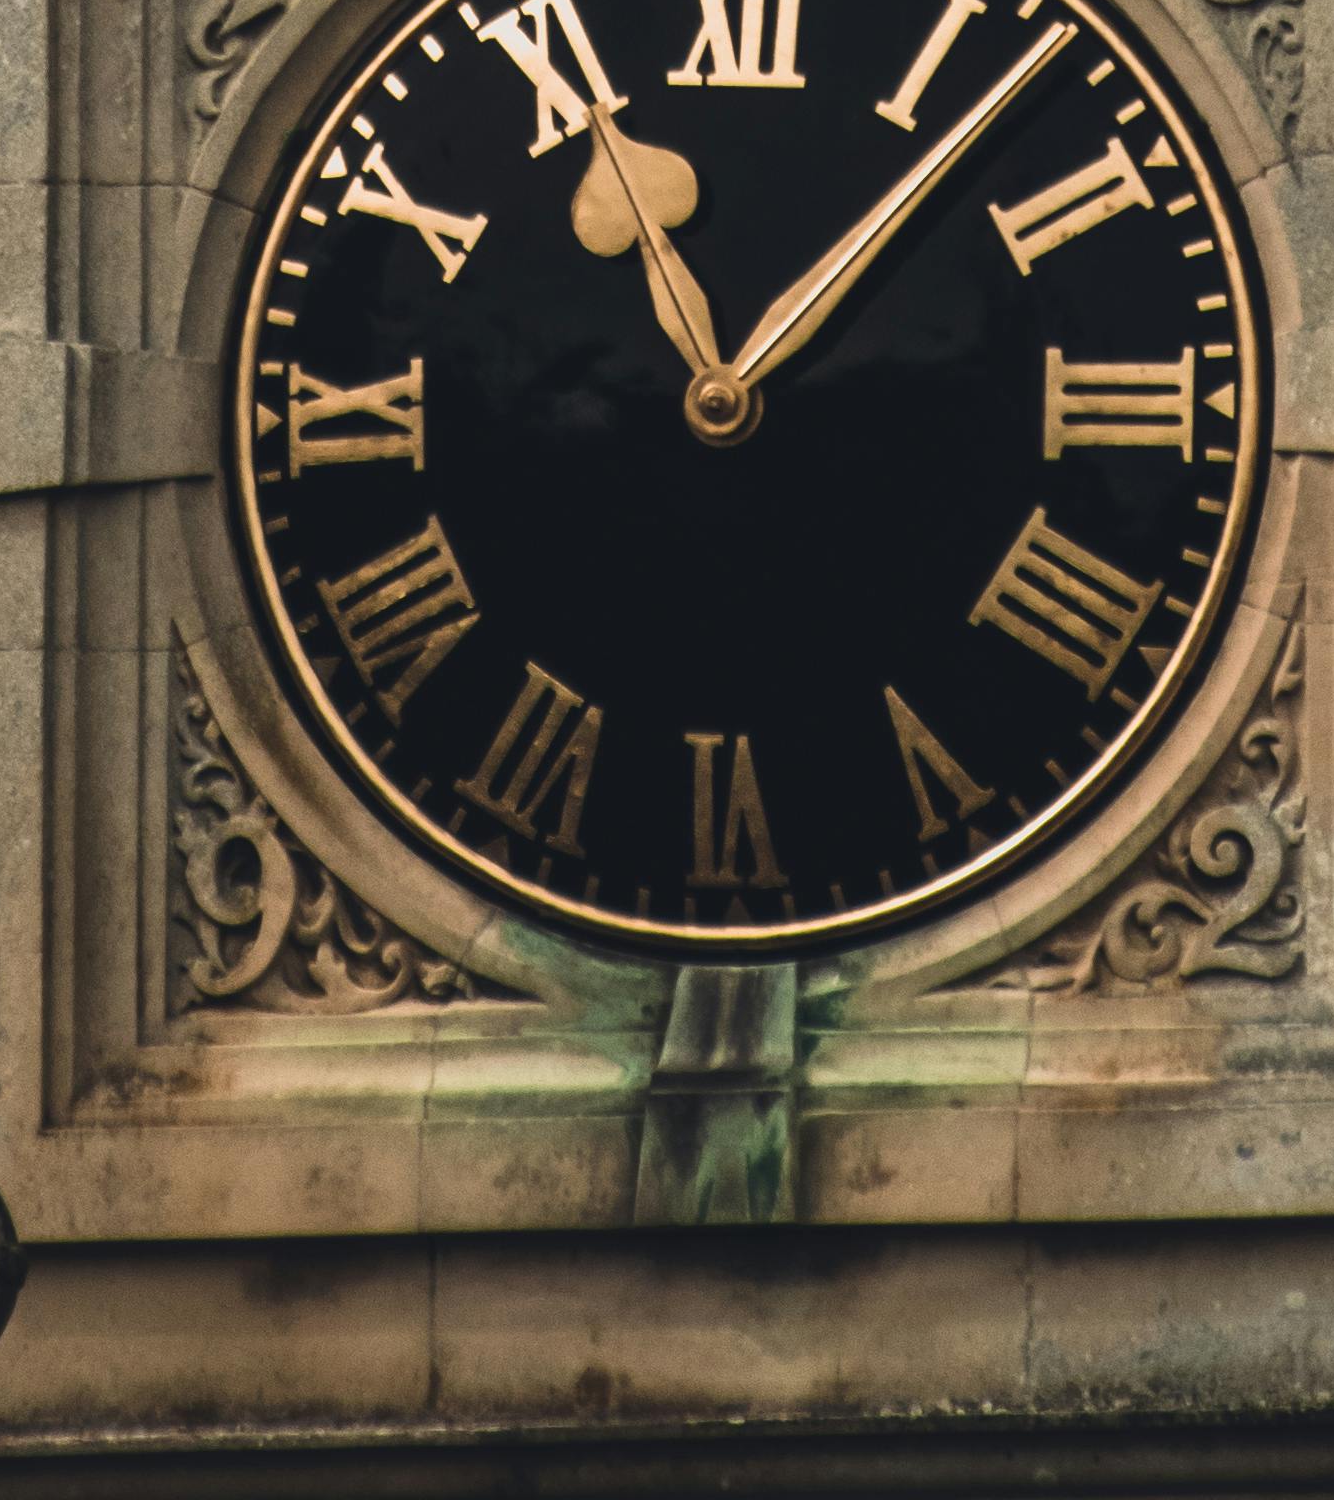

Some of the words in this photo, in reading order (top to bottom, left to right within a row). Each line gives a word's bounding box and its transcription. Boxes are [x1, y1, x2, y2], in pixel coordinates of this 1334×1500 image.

[338, 141, 489, 283] X
[988, 136, 1156, 276] II
[287, 357, 425, 478] IX
[1044, 347, 1195, 463] III
[316, 513, 482, 730] VIII
[967, 506, 1164, 703] IIII
[453, 661, 603, 859] VII
[684, 733, 789, 889] VI
[883, 685, 995, 842] V
